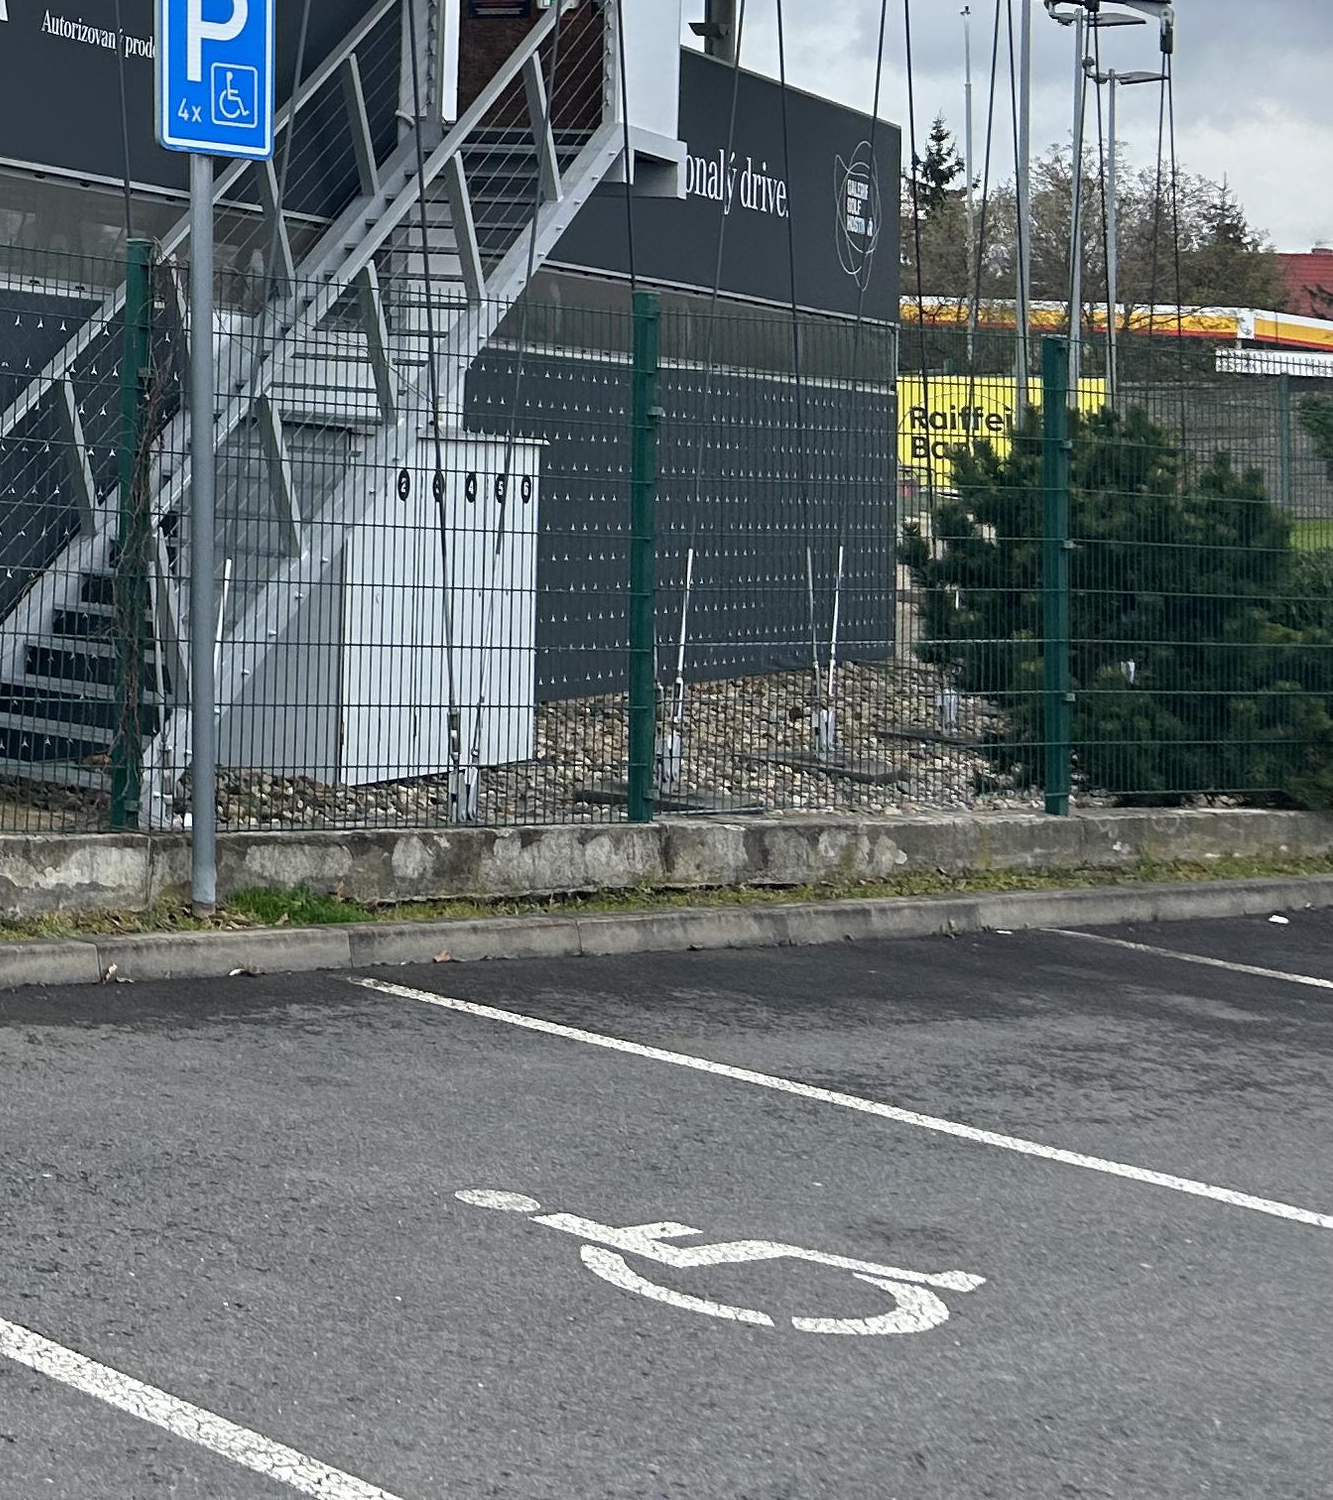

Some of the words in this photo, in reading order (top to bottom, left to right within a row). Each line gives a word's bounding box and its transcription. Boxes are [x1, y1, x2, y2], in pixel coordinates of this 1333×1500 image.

[41, 9, 124, 55] Autorizovan
[178, 98, 202, 123] 4x
[686, 148, 737, 215] onalý
[740, 156, 789, 218] drive.
[909, 404, 1013, 431] Raiffei
